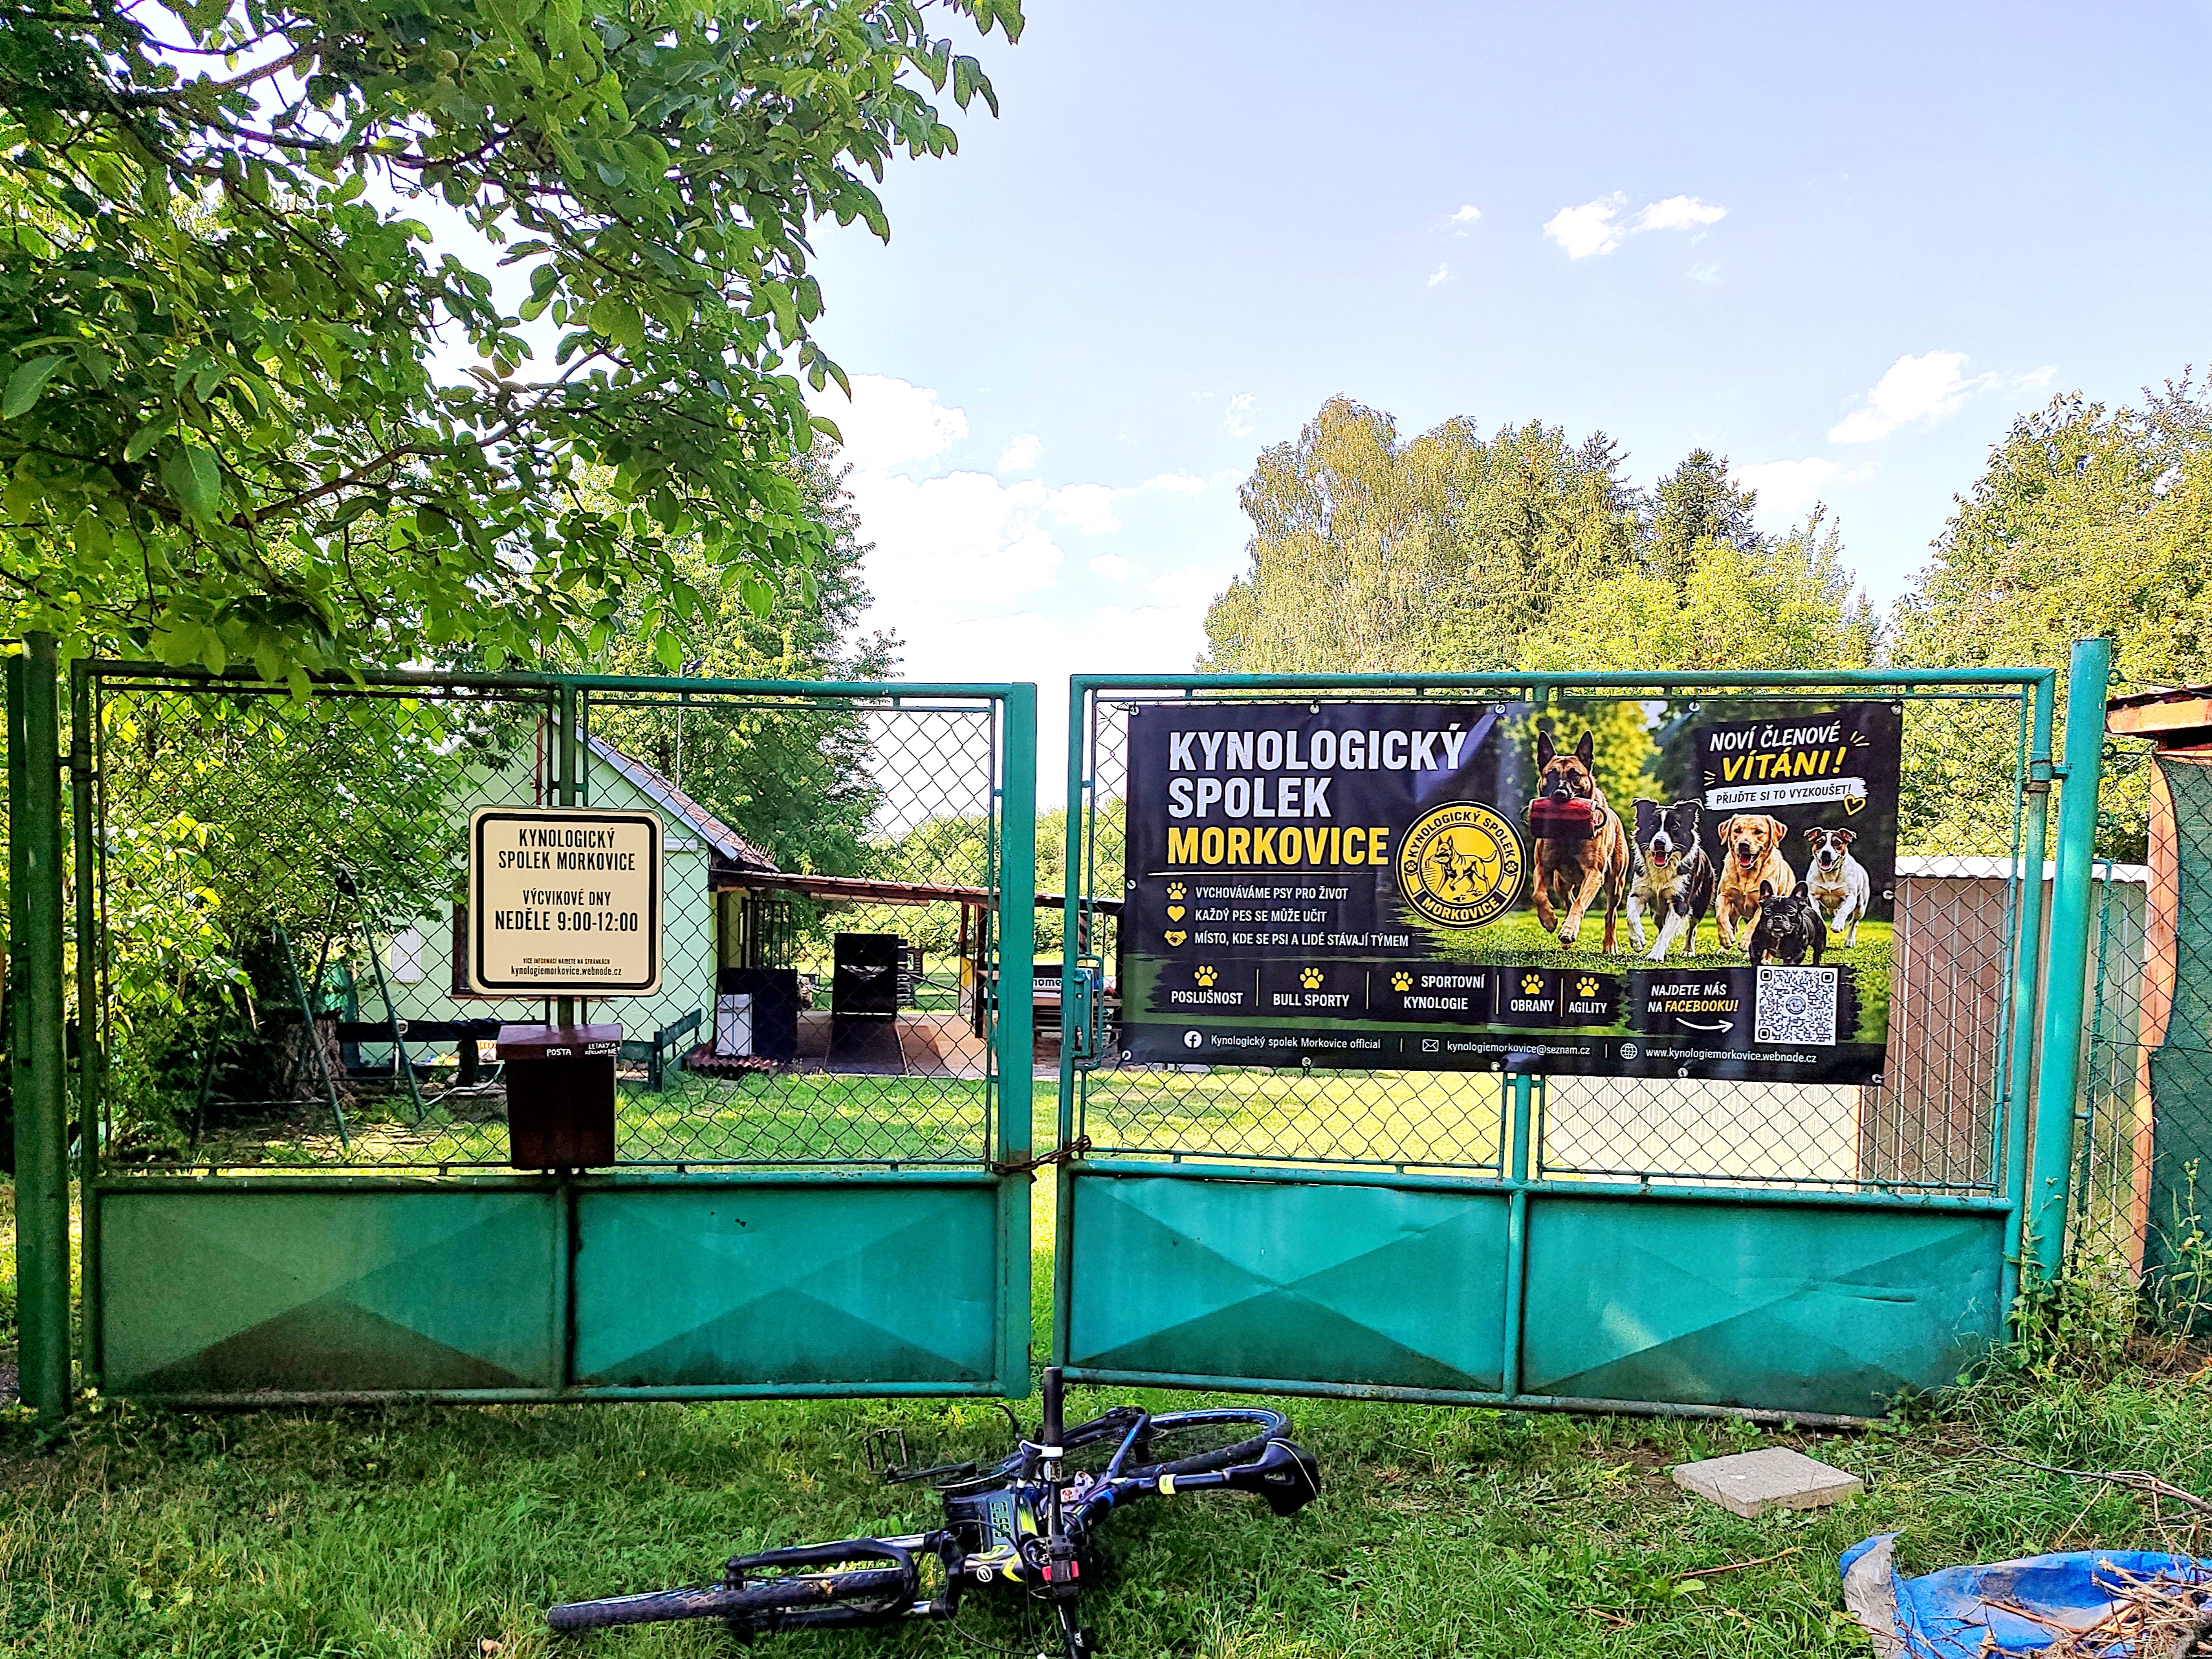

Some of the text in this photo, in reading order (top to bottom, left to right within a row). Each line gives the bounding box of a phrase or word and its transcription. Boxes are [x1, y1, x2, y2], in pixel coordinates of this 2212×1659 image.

[1709, 720, 1841, 752] NOVÍ ČLENOVÉ
[1169, 723, 1467, 771] KYNOLOGICKÝ
[1723, 747, 1846, 782] VÍTÁNI!
[1168, 777, 1331, 818] SPOLEK
[1716, 784, 1852, 804] PŘIJĎTE SI TO VYZKOUŠET!
[520, 828, 615, 848] KYNOLOGICKÝ
[1408, 811, 1515, 859] KYNOLOGICKÝ SPOLEK
[1167, 827, 1389, 866] MORKOVICE
[499, 851, 635, 870] SPOLEK MORKOVICE
[523, 888, 611, 906] VÝCVIKOVÉ DNY
[1196, 885, 1348, 899] VYCHOVÁVÁME PSY PRO ŽIVOT
[1195, 907, 1327, 922] KAŽDÝ PES SE MŮŽE UČIT
[1421, 897, 1500, 920] MORKOVICE
[495, 907, 638, 931] NEDĚLE 9:00-12:00
[1195, 930, 1408, 947] MÍSTO, KDE SE PSI A LIDÉ STÁVAJÍ TÝMEM
[511, 965, 622, 976] kynologiemorkovice.webnode.cz
[1421, 974, 1485, 989] SPORTOVNÍ
[1651, 982, 1727, 996] NAJDETE NÁS
[1171, 989, 1243, 1004] POSLUŠNOST
[1273, 993, 1350, 1007] BULL SPORTY
[1404, 996, 1468, 1010] KYNOLOGIE
[1511, 1000, 1554, 1011] OBRANY
[1568, 1002, 1607, 1014] AGILITY
[1647, 999, 1739, 1013] NA FACEBOOKU!
[1211, 1035, 1381, 1049] Kynologický spolek Morkovice official
[1447, 1040, 1591, 1056] kynologiemorkovice@seznam.cz
[1645, 1048, 1817, 1063] www.kynologiemorkovice.webnode.cz
